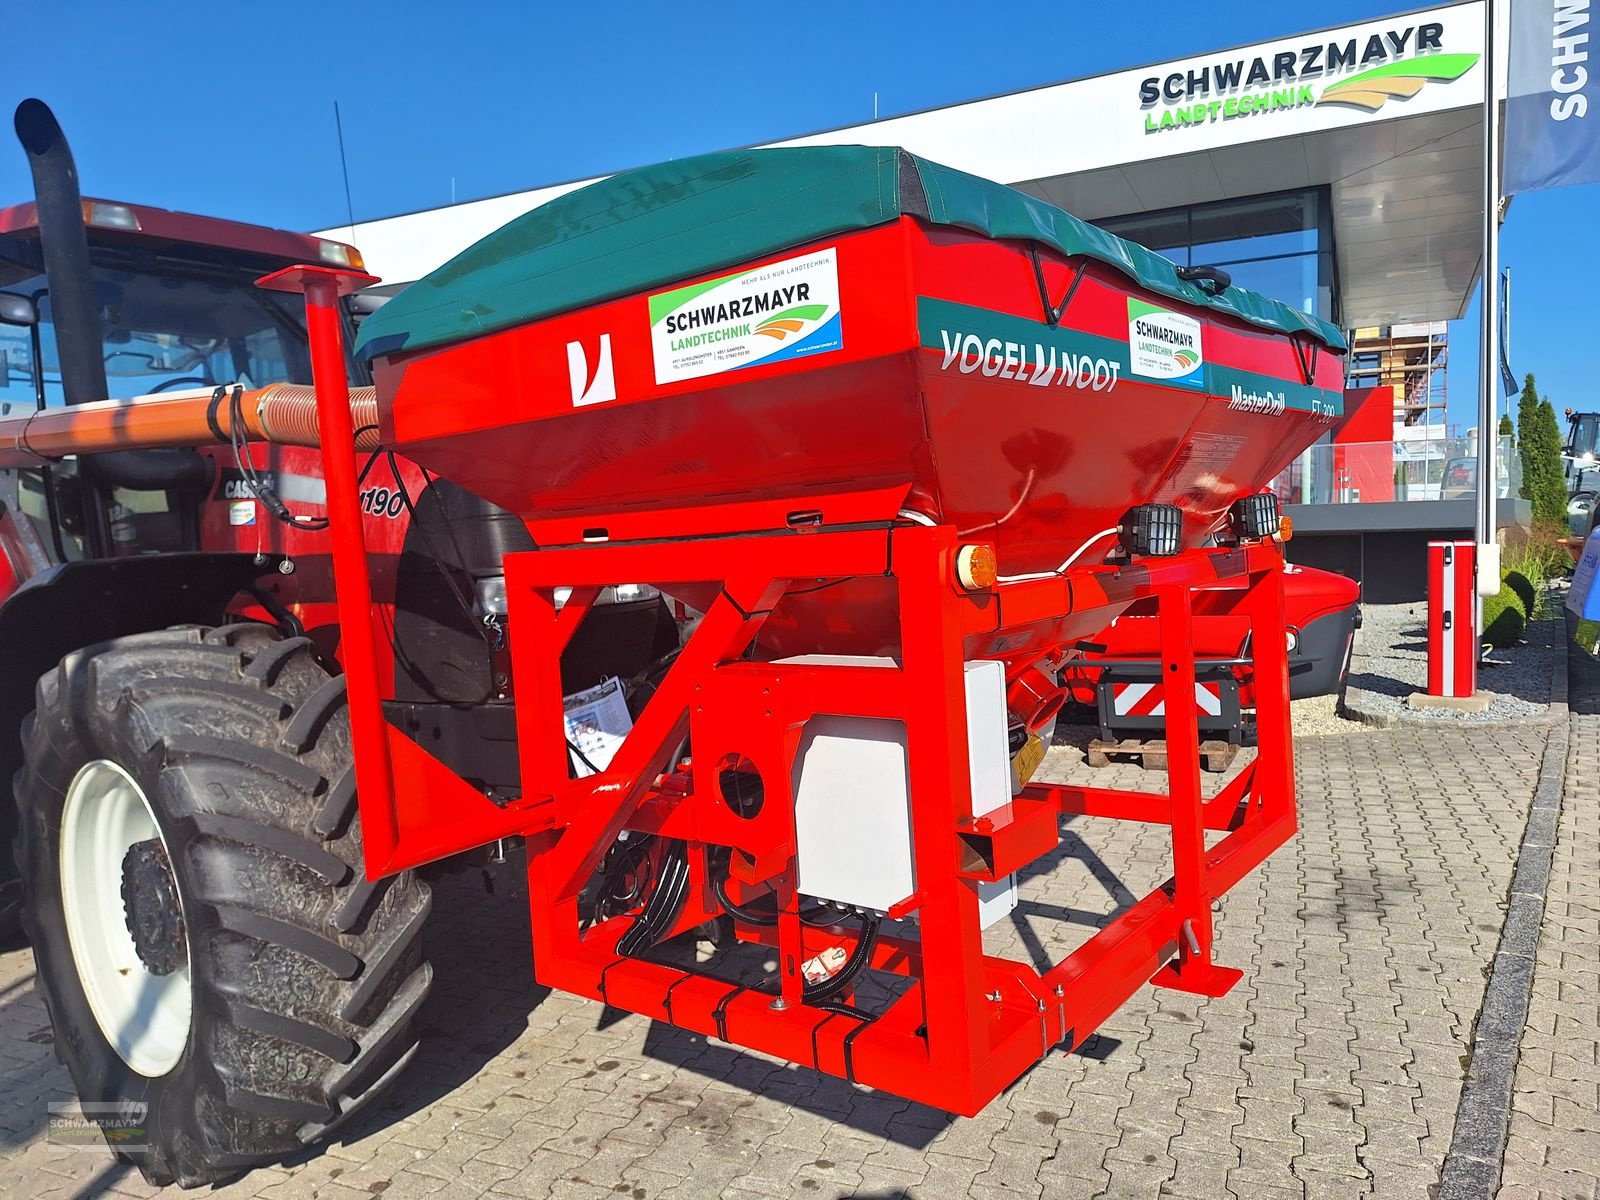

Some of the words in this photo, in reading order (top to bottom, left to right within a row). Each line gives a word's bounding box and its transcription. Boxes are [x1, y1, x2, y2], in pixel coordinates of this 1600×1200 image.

[1140, 22, 1444, 107] SCHWARZMAYR
[1145, 84, 1314, 133] LANDTECHNIK
[742, 277, 758, 285] MEHR
[760, 273, 770, 281] ALS
[772, 270, 785, 278] NUR
[666, 283, 809, 333] SCHWARZMAYR
[671, 323, 752, 351] LANDTECHNIK
[1136, 320, 1193, 348] SCHWARZMAYR
[1138, 341, 1173, 357] LANDTECHNIK
[940, 329, 1029, 381] VOGEL
[1056, 352, 1121, 393] NOOT
[1228, 384, 1285, 417] MasterDrill
[360, 488, 404, 518] 190
